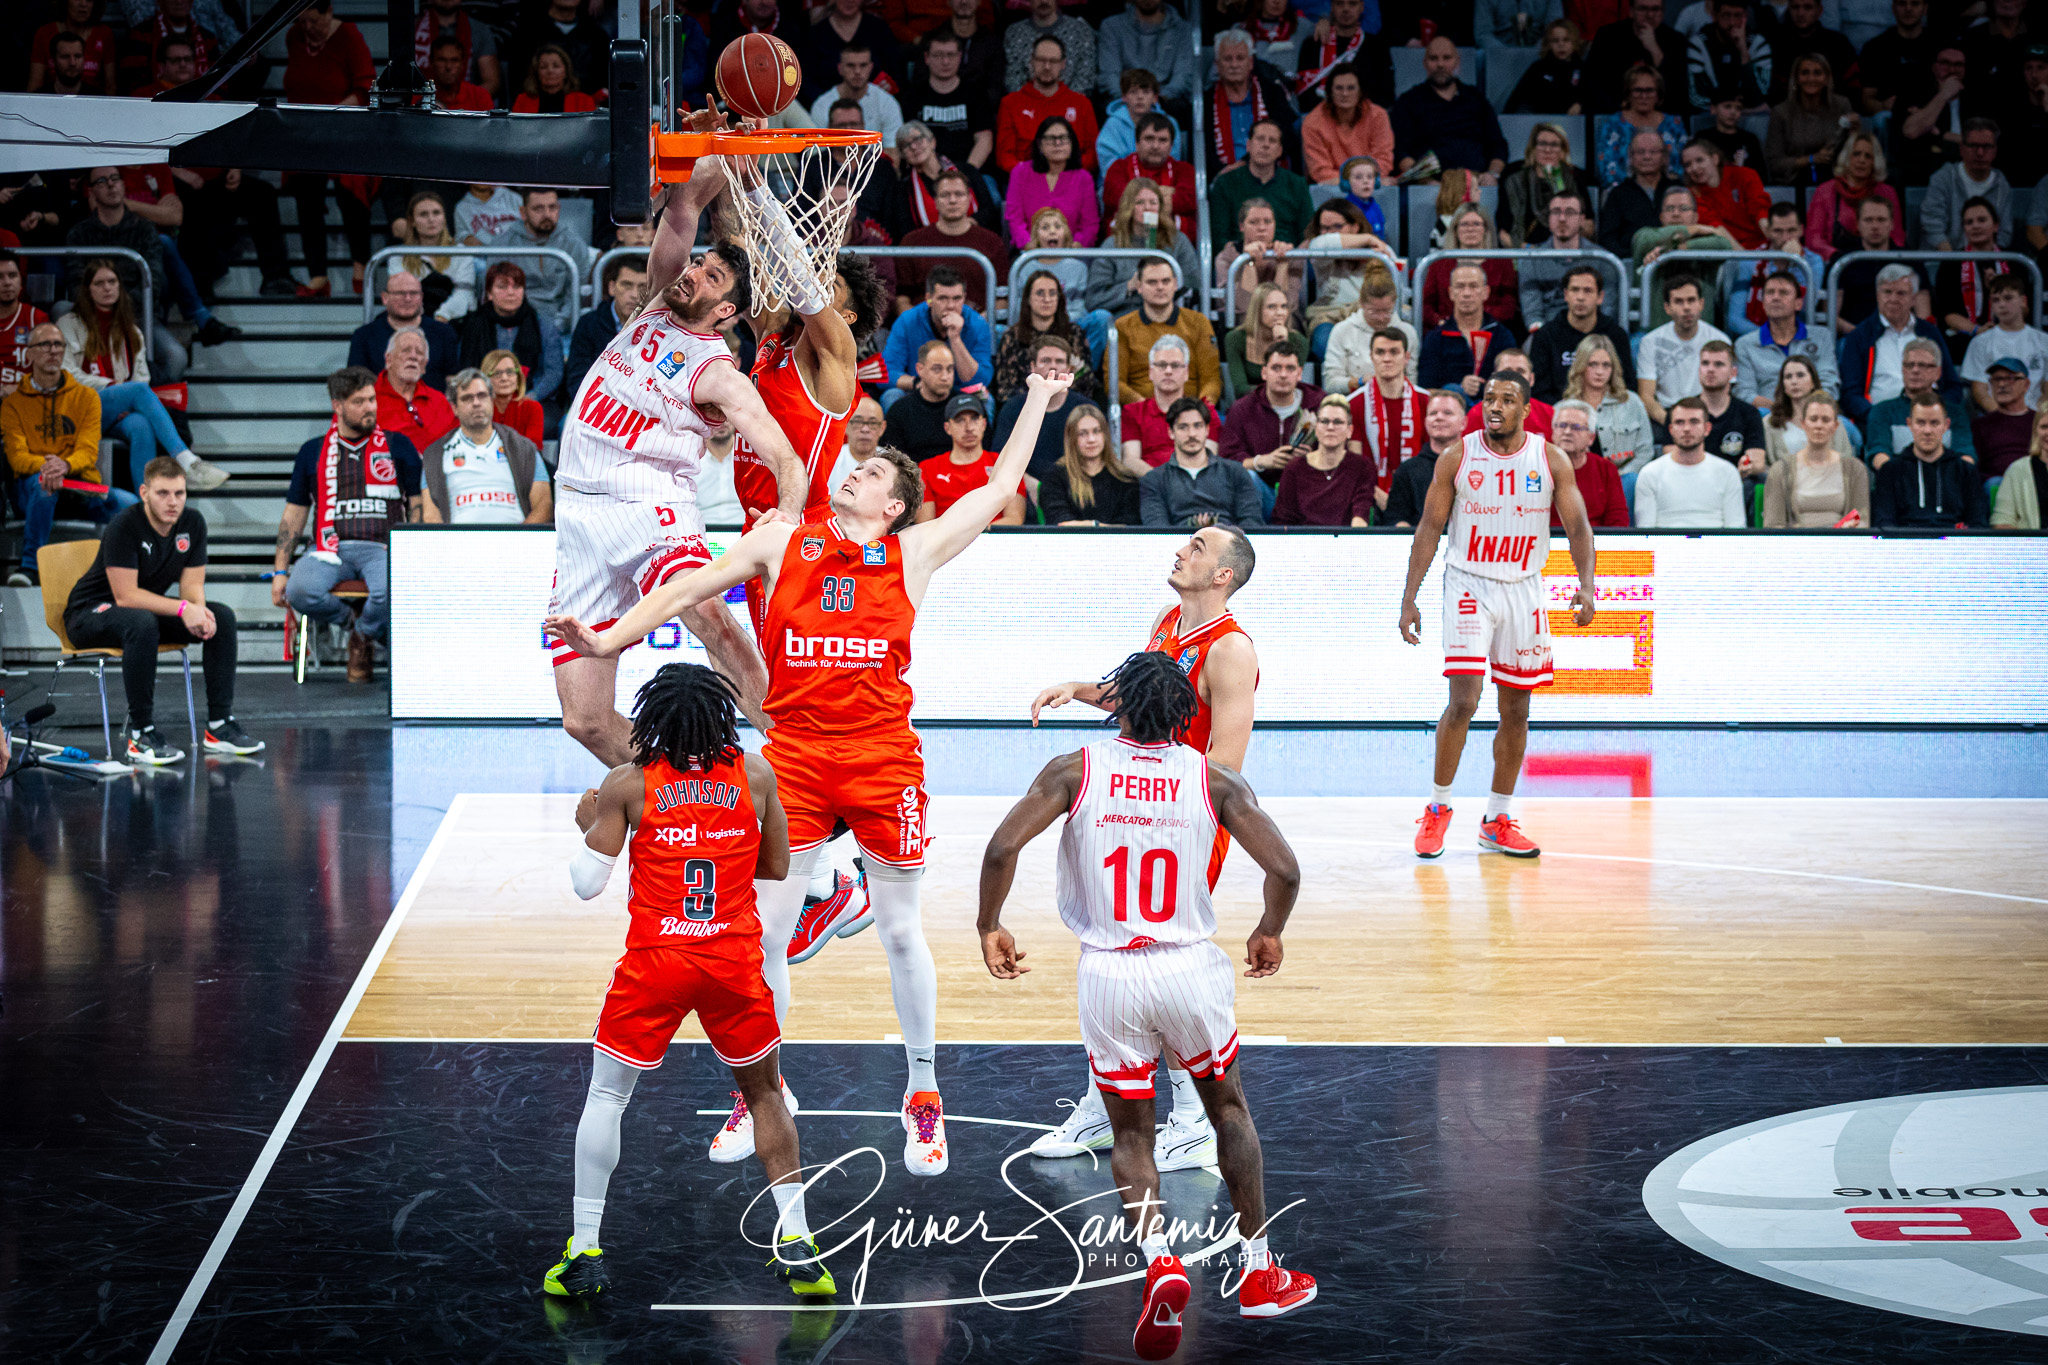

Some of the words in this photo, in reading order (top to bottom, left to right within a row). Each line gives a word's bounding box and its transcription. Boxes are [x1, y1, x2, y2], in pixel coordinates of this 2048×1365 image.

[923, 104, 967, 123] PUMA
[641, 329, 666, 363] 5
[653, 384, 684, 411] SPNTIS
[1495, 469, 1516, 495] 11
[336, 498, 387, 514] rose
[655, 506, 676, 526] 5
[1467, 525, 1538, 571] KNAUF
[821, 575, 856, 612] 33
[785, 628, 888, 659] brose
[786, 659, 818, 668] Technik
[820, 659, 833, 668] für
[835, 660, 883, 669] Automobile
[655, 779, 741, 813] JOHNSON
[1109, 773, 1181, 802] PERRY
[654, 824, 697, 846] xpd
[706, 828, 746, 841] logistics
[1102, 814, 1190, 829] MERCATORLEASING
[683, 858, 717, 922] 3
[1103, 845, 1179, 923] 10
